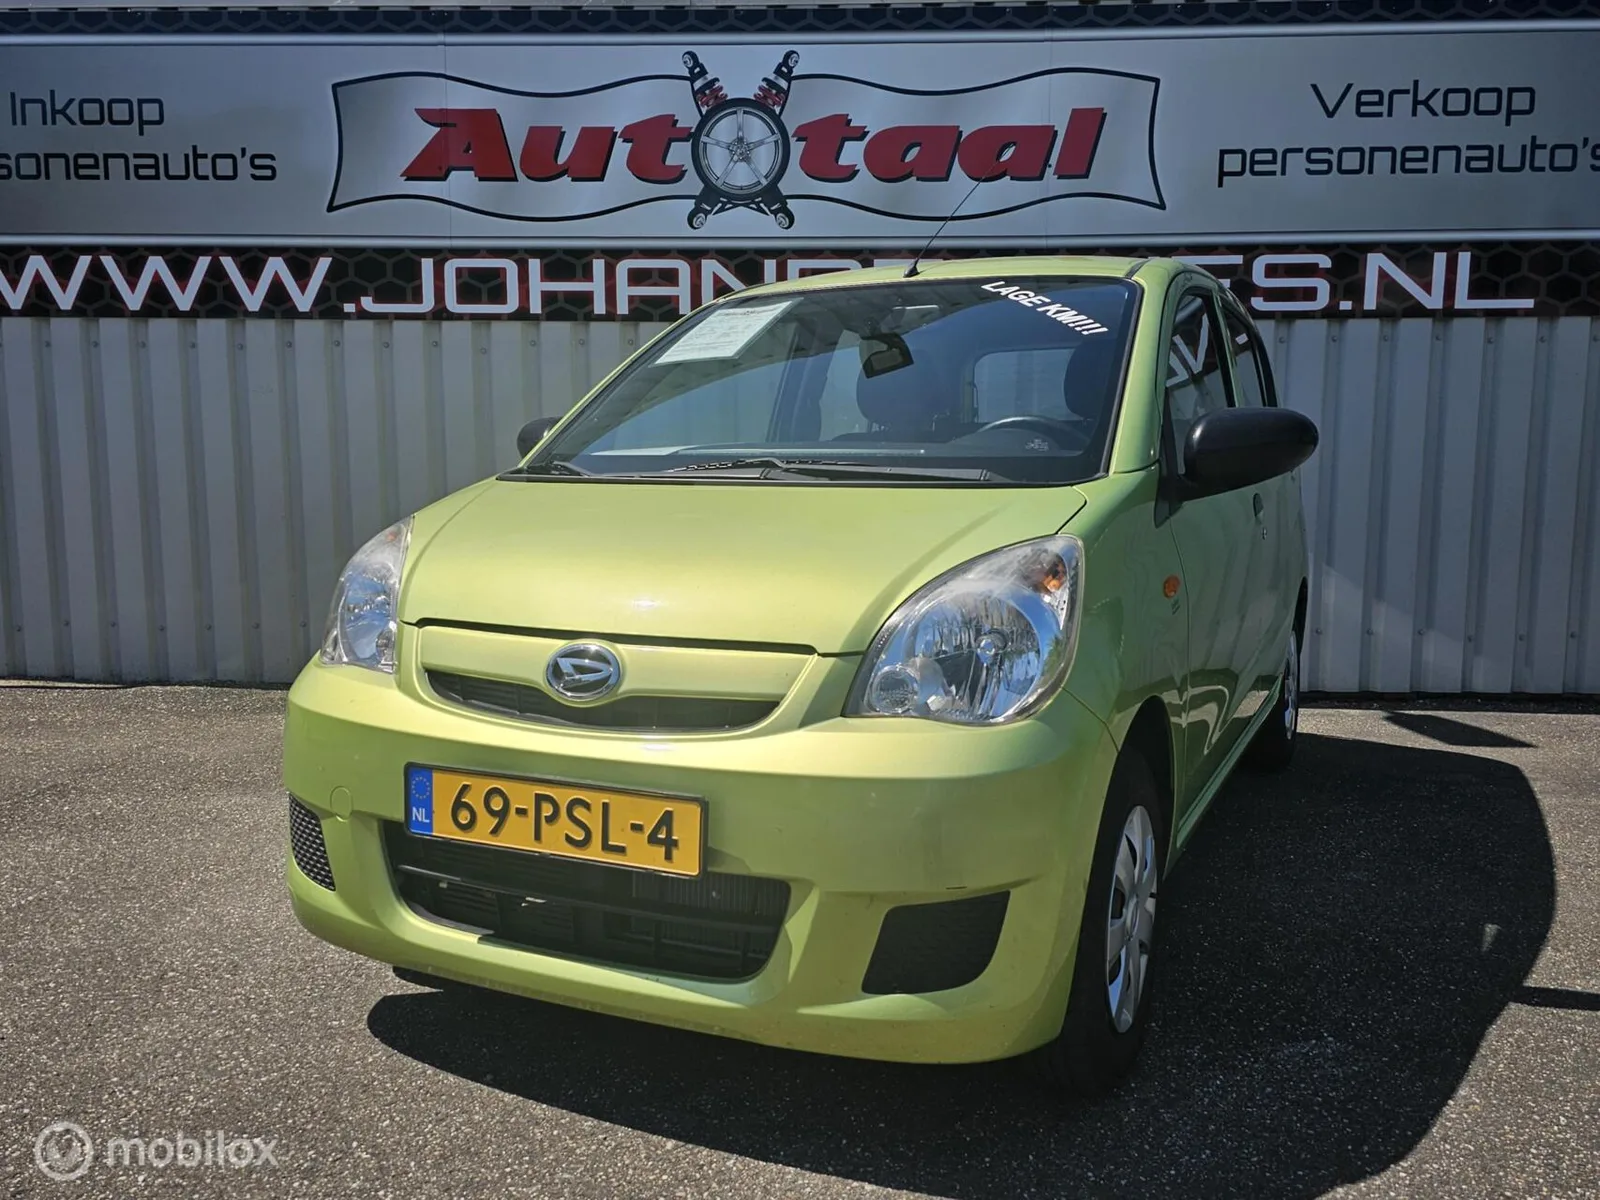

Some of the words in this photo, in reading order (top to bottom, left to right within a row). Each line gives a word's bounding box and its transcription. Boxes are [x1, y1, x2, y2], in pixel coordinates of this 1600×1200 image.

[10, 89, 165, 136] Inkoop
[1310, 79, 1536, 127] Verkoop
[981, 281, 1051, 307] LAGE
[1036, 303, 1109, 335] KM!!!
[412, 805, 430, 823] NL
[450, 781, 679, 863] 69-PSL-4
